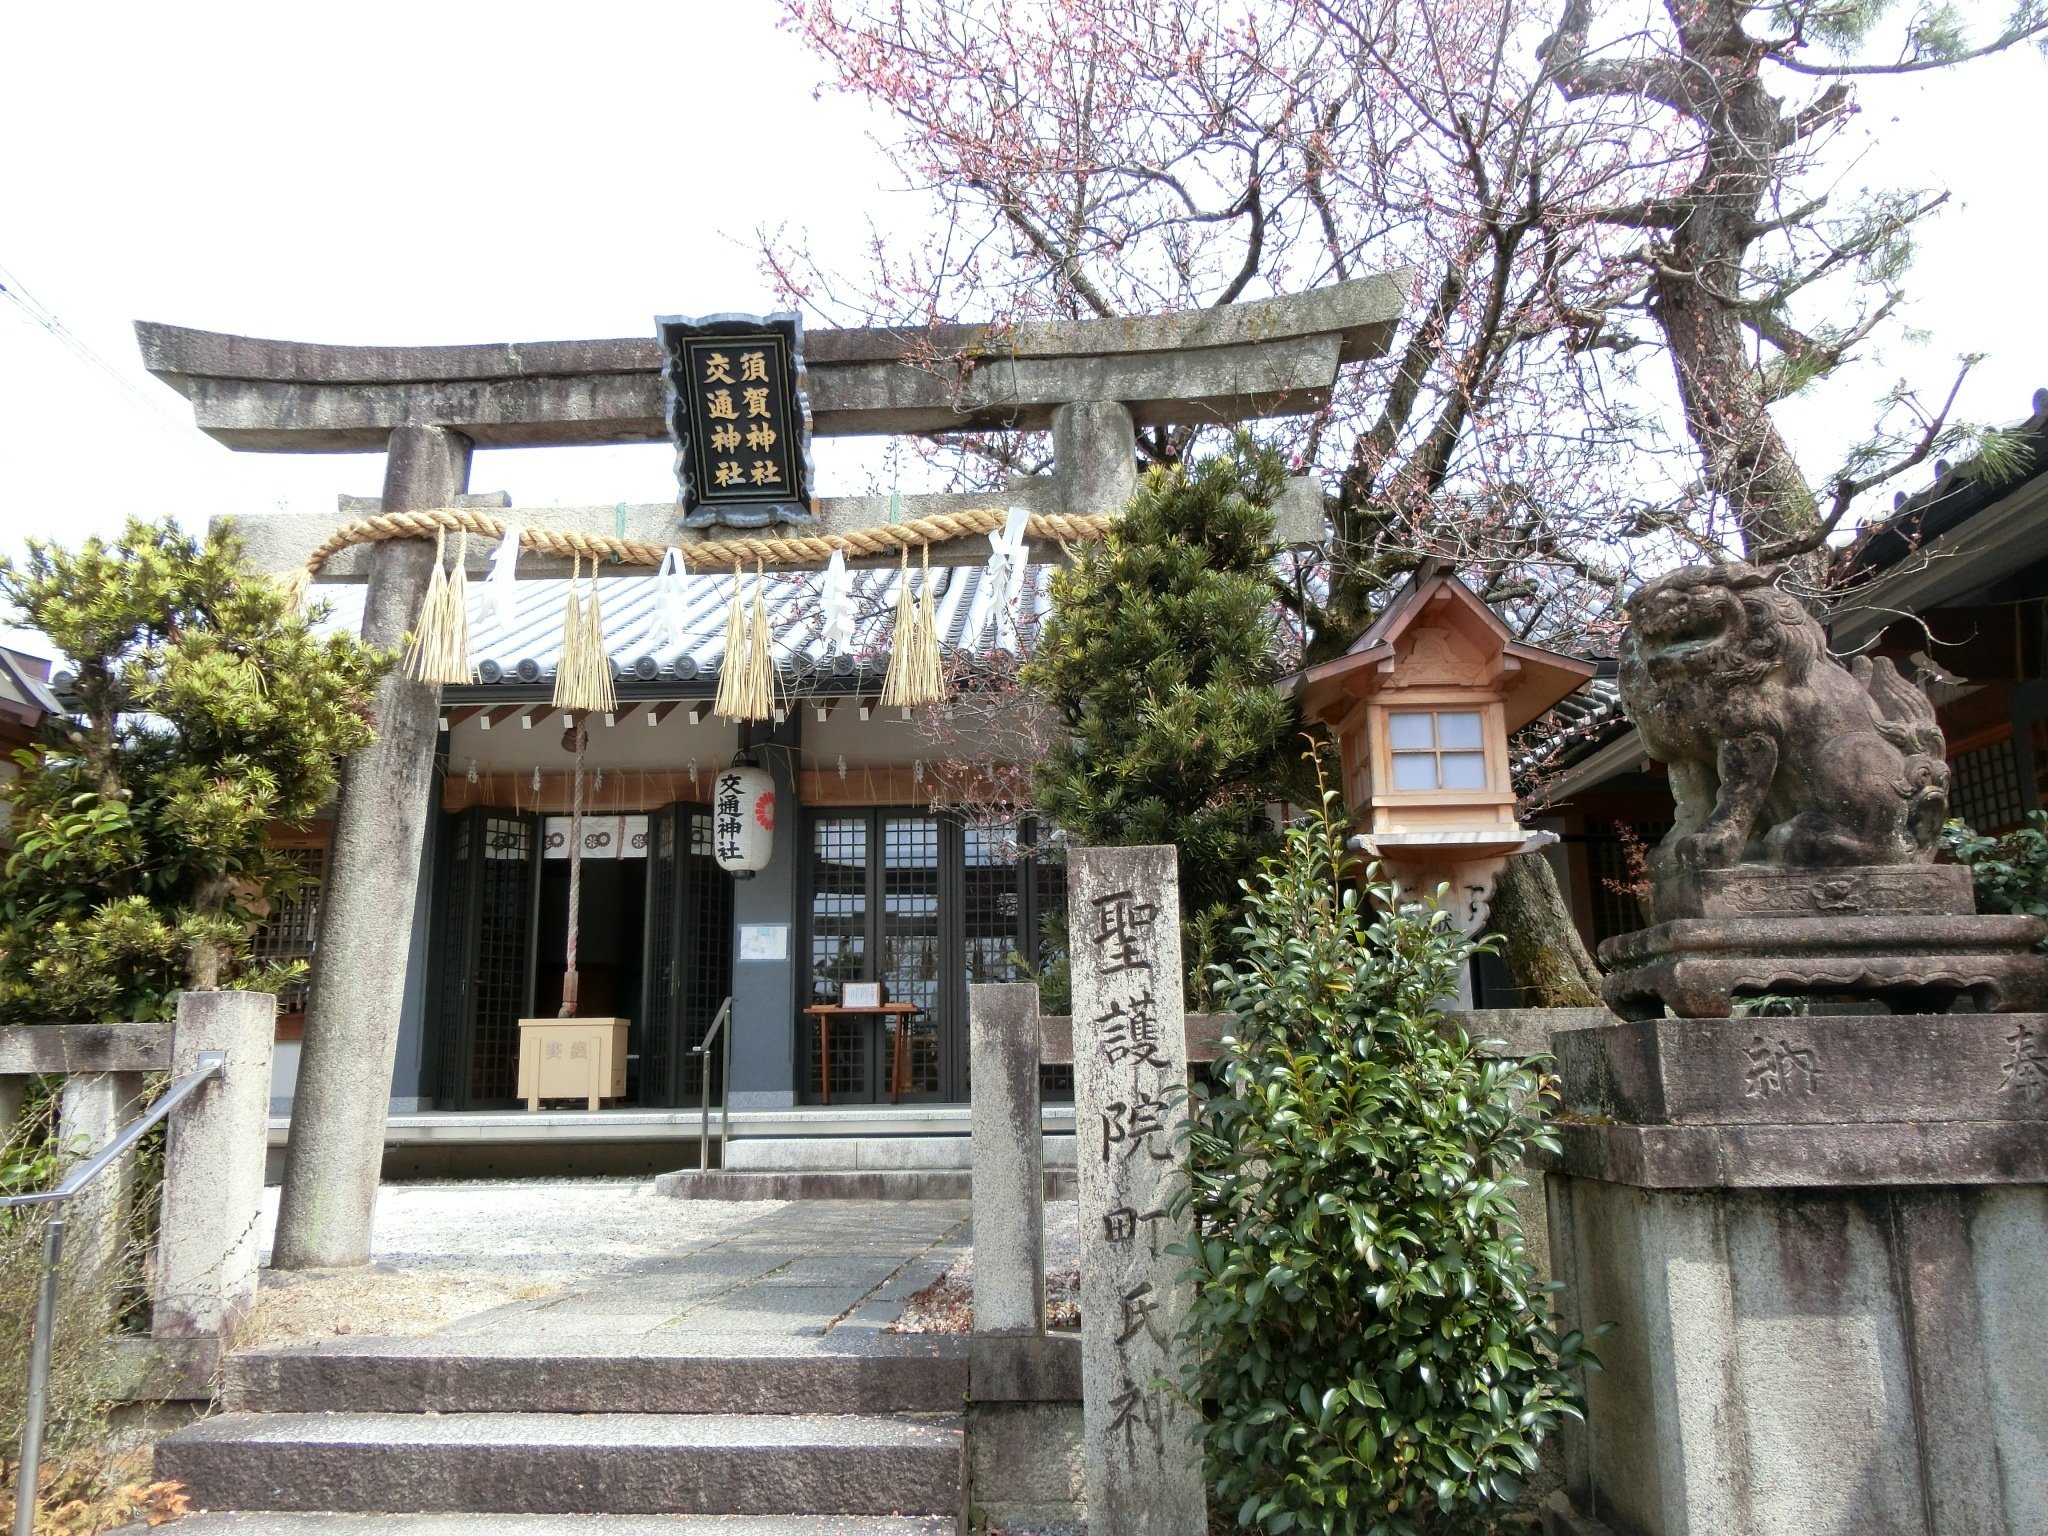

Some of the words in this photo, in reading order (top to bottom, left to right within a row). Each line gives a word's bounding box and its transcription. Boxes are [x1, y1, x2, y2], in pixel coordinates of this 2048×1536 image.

[704, 353, 747, 488] 交通神社
[740, 351, 781, 487] 須賀神社
[717, 773, 746, 862] 交通神社
